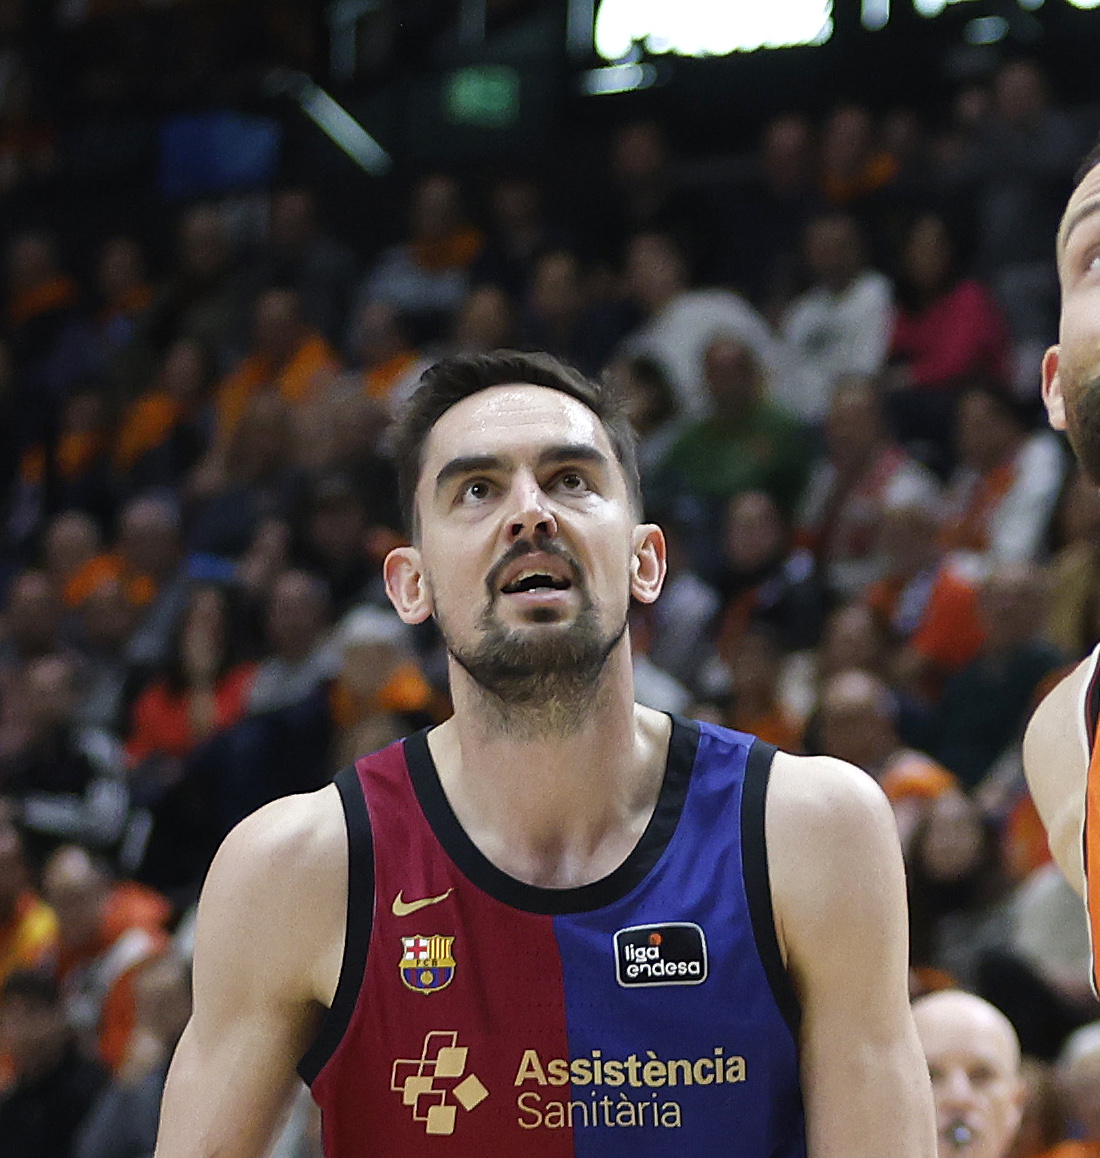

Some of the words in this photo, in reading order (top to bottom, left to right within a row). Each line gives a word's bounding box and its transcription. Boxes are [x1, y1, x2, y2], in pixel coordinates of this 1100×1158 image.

[625, 944, 660, 963] liga
[627, 959, 701, 977] endesa
[514, 1047, 747, 1088] Assistència
[517, 1091, 682, 1129] Sanitària
